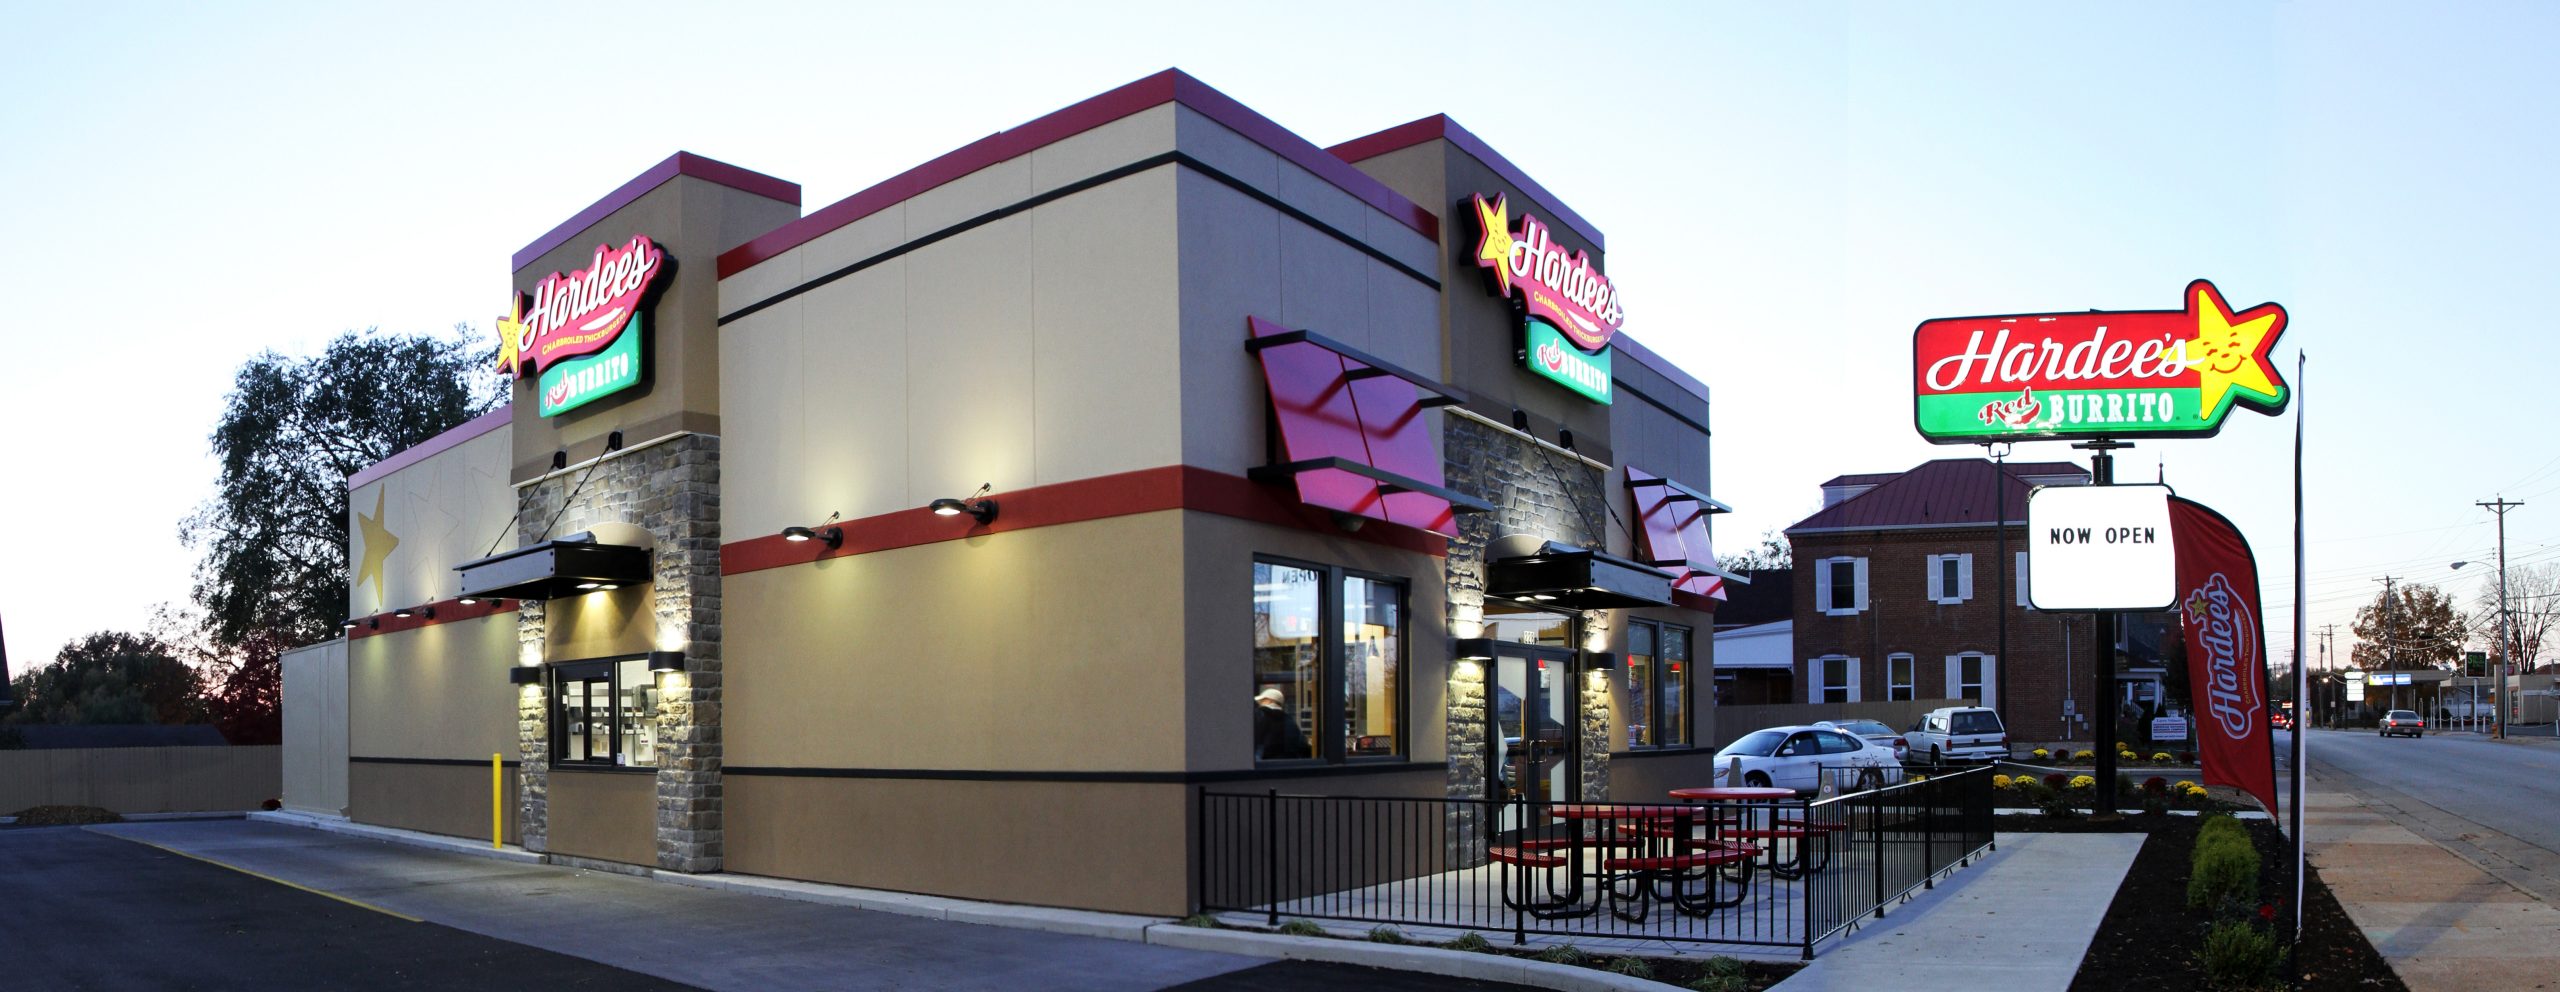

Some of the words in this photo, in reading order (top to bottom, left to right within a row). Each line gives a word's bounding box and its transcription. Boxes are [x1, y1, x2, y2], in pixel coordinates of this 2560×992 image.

[518, 238, 655, 352] Hardee's
[1509, 221, 1624, 326] Hardee's
[541, 334, 584, 355] CHARBROILED
[1925, 326, 2205, 391] Hardee's
[568, 351, 629, 398] BURRITO
[1560, 350, 1608, 396] BURRITO
[1978, 386, 2040, 427] Red
[2048, 391, 2174, 424] BURRITO
[2050, 527, 2091, 545] NOW
[2105, 526, 2156, 544] OPEN
[2206, 580, 2246, 732] Hardee's
